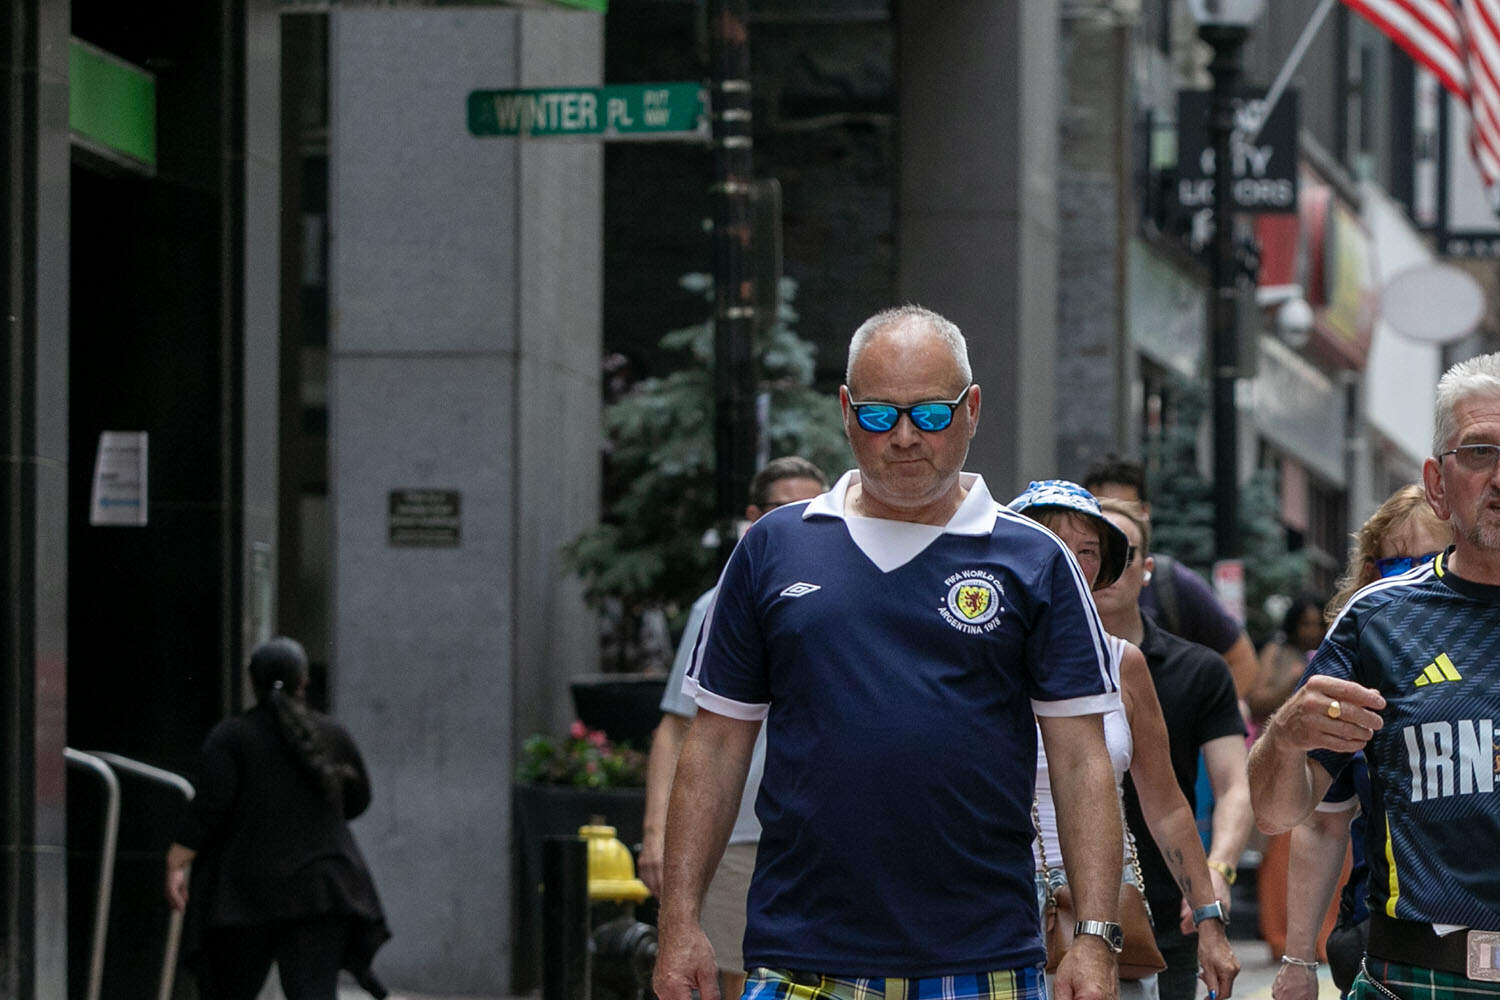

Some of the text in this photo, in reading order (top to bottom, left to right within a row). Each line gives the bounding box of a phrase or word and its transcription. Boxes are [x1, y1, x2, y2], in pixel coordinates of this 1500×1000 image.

[495, 92, 634, 130] WINTER PL
[944, 572, 963, 587] FIFA
[961, 569, 995, 581] WORLD
[937, 607, 983, 635] ARGENTINA
